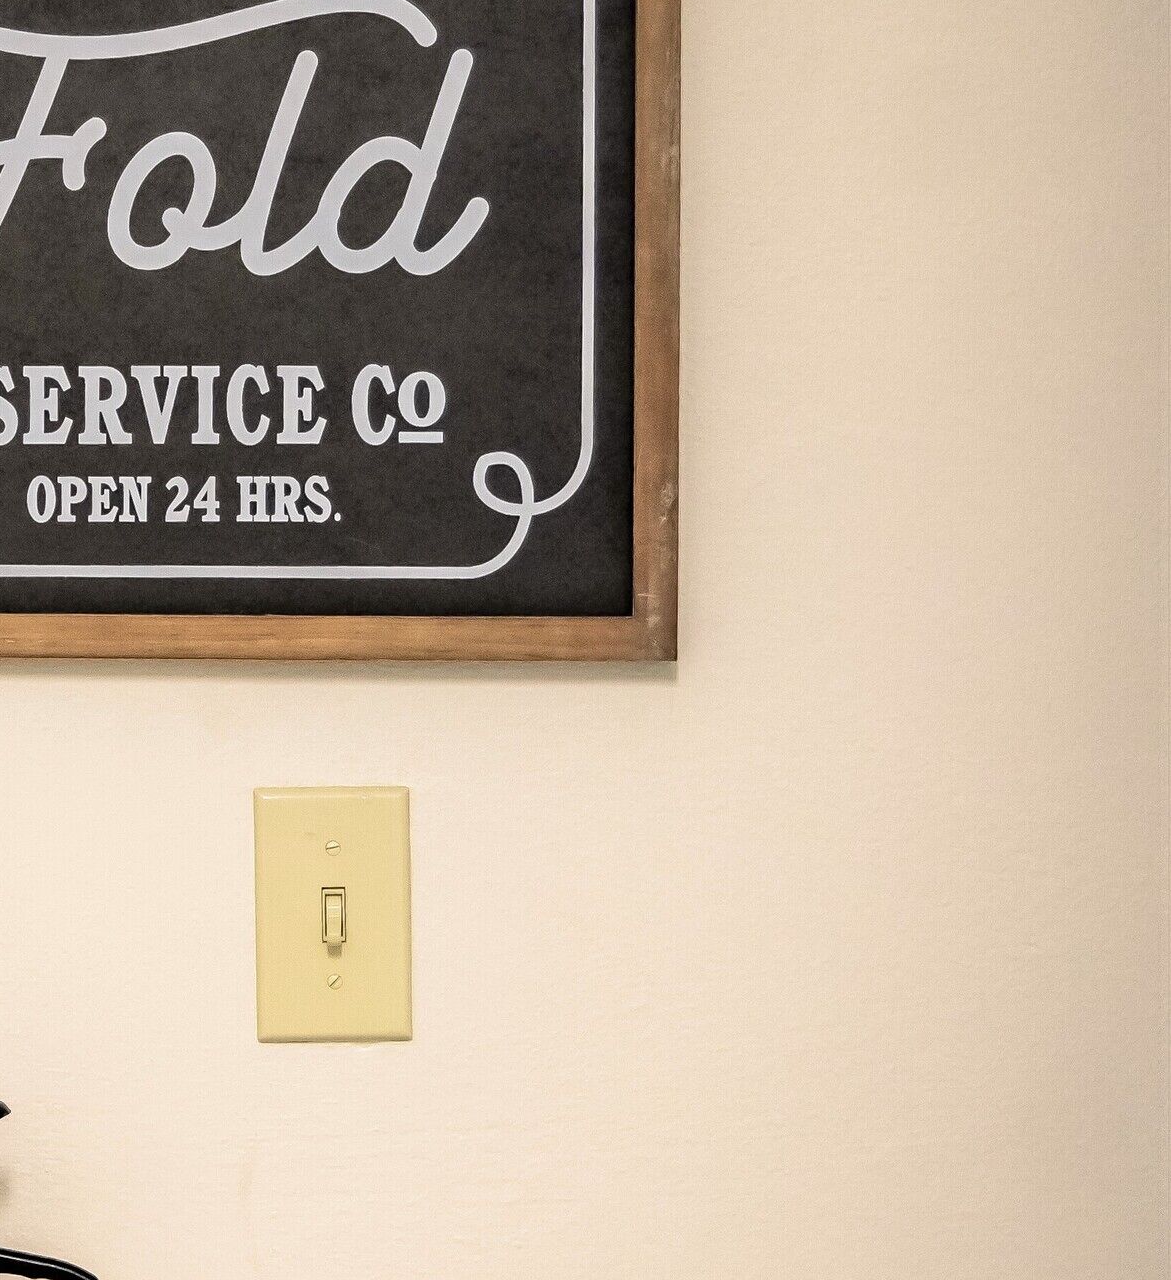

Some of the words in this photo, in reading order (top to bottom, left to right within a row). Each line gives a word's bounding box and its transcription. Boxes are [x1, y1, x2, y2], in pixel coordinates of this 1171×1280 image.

[351, 363, 447, 446] Co
[27, 475, 153, 524] OPEN
[165, 475, 221, 524] 24
[236, 474, 342, 524] HRS.
